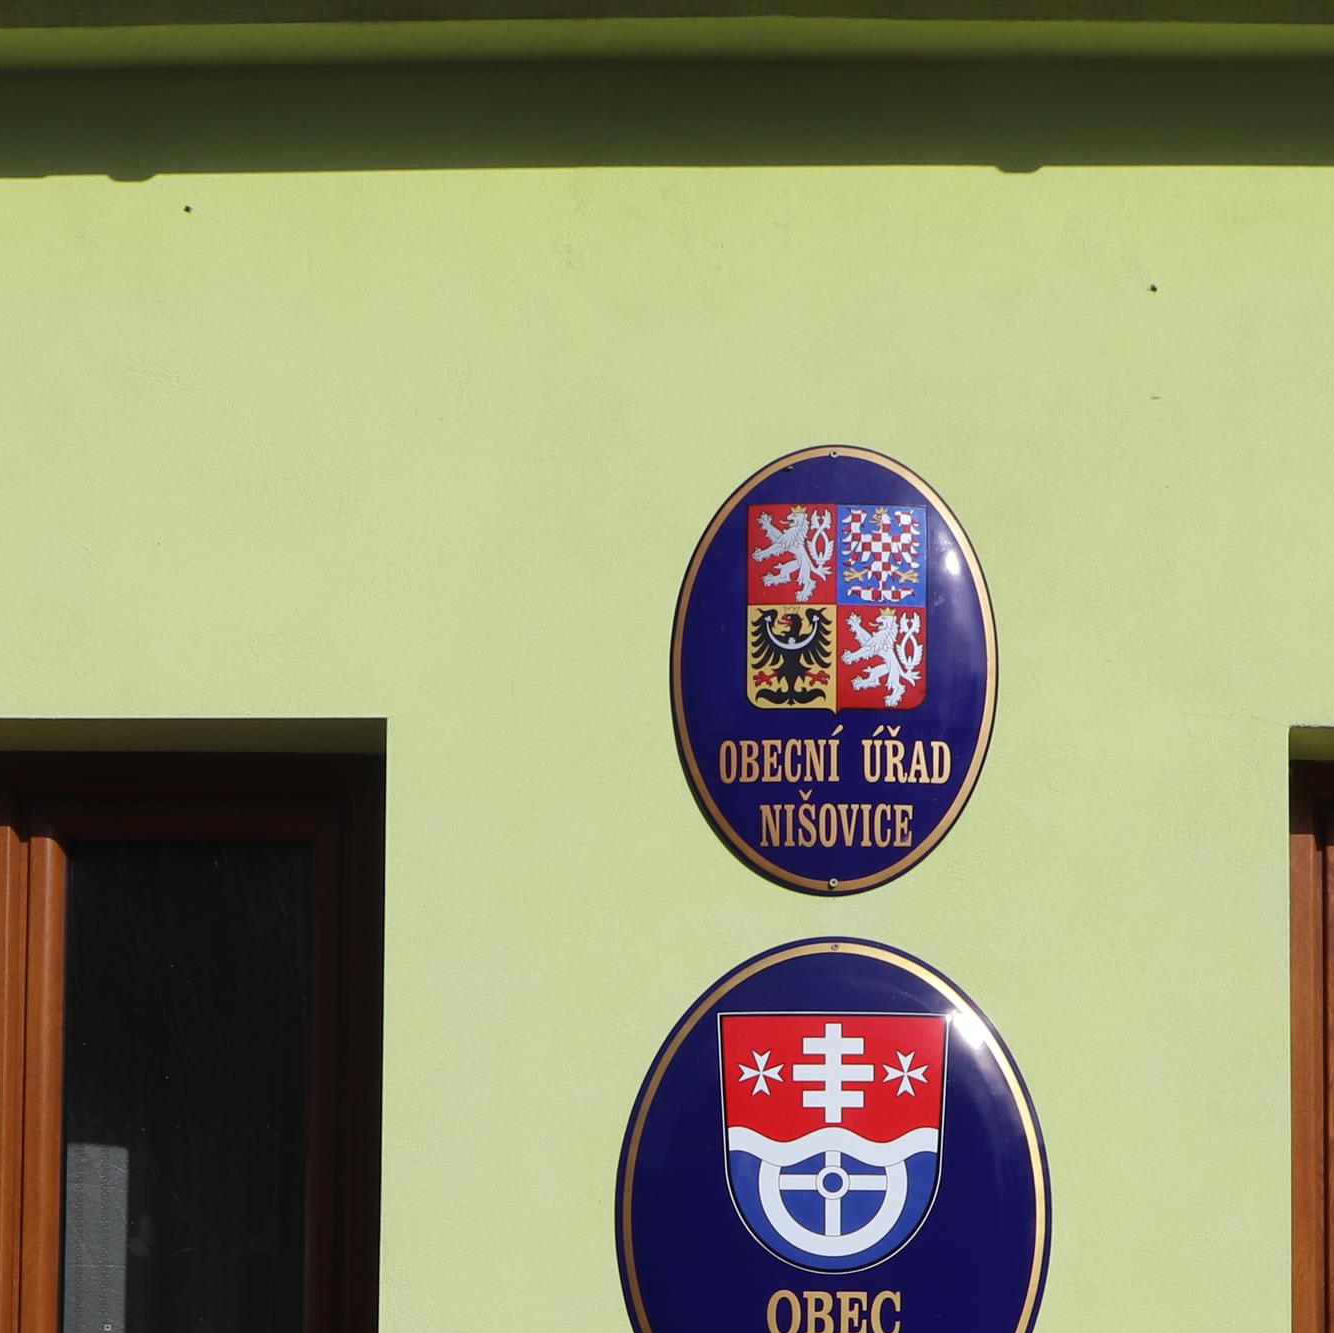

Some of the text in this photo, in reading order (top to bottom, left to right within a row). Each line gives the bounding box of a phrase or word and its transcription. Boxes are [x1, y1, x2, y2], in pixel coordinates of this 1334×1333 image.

[719, 724, 951, 784] OBECNÍ ÚŘAD
[759, 790, 914, 847] NIŠOVICE
